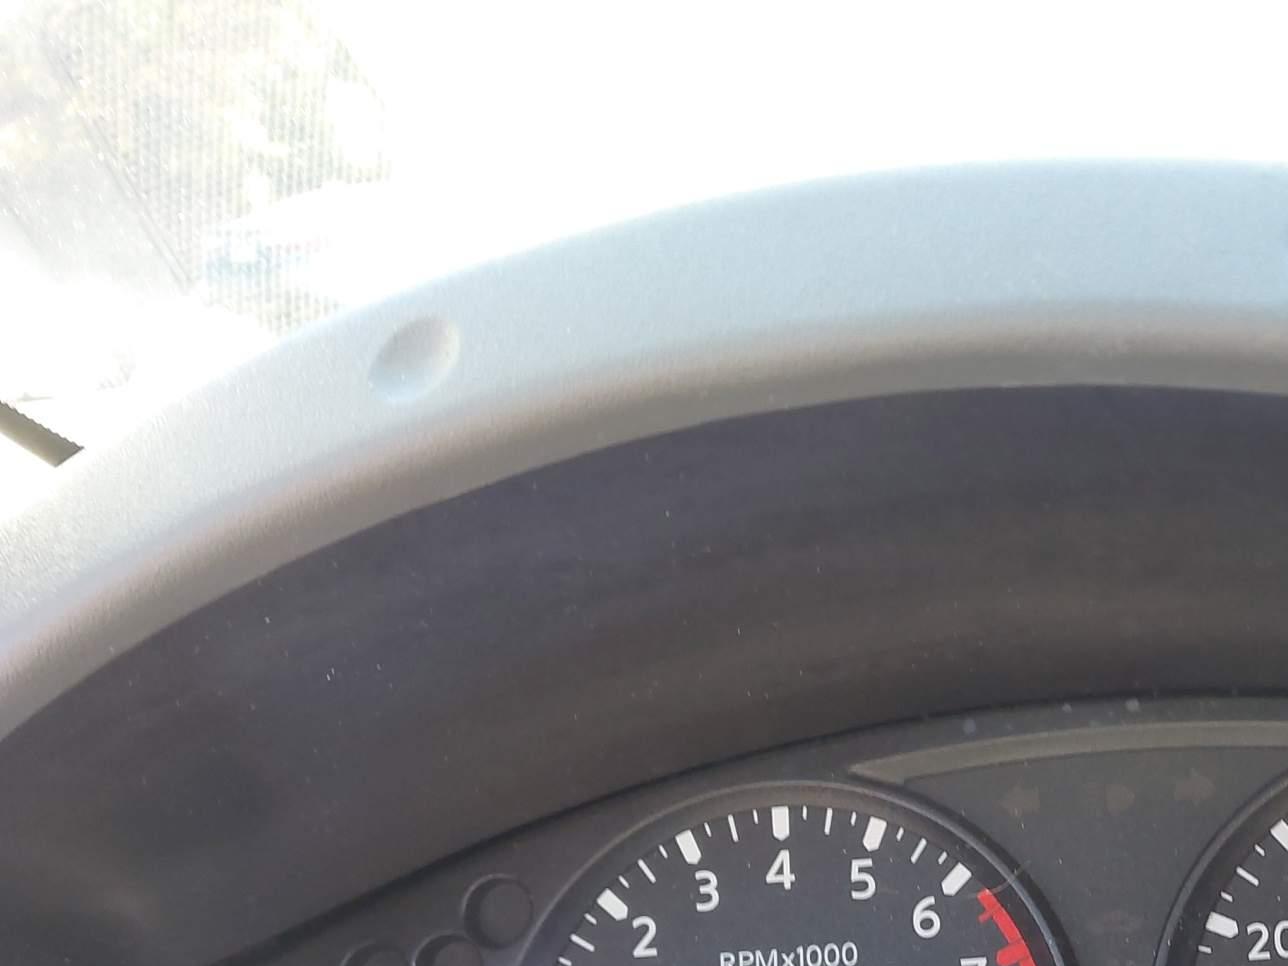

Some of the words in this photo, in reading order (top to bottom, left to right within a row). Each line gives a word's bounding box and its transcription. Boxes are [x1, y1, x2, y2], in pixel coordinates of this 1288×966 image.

[765, 849, 796, 890] 4
[850, 858, 876, 900] 5
[695, 870, 720, 912] 3
[632, 915, 658, 958] 2
[912, 895, 941, 938] 6
